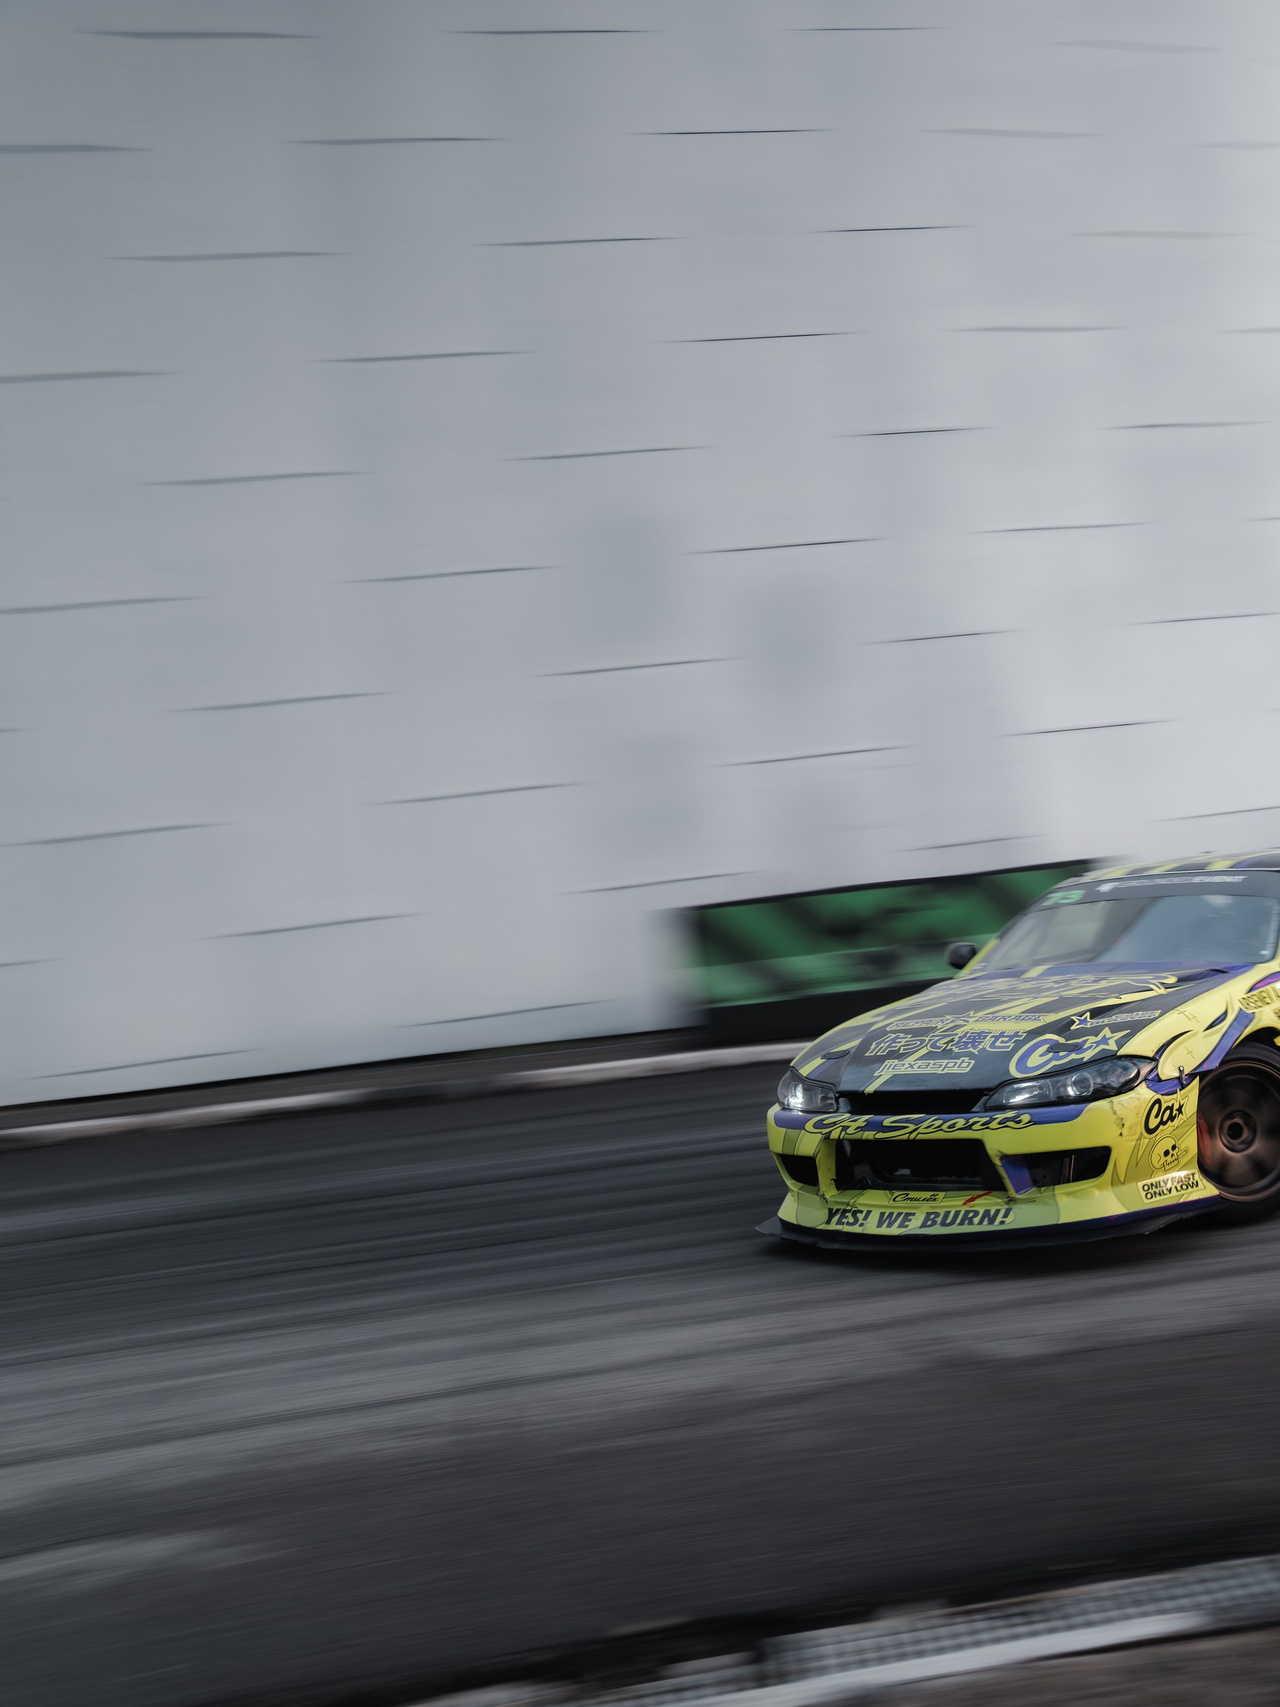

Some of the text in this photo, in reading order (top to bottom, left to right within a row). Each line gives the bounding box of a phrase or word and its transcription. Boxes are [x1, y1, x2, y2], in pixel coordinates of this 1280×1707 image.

[873, 1110, 1035, 1141] Sports
[1144, 1097, 1178, 1136] Ca
[1142, 1173, 1196, 1192] ONLY FAST
[1144, 1180, 1199, 1201] ONLY LOW
[824, 1207, 1013, 1229] YES! WE BURN!
